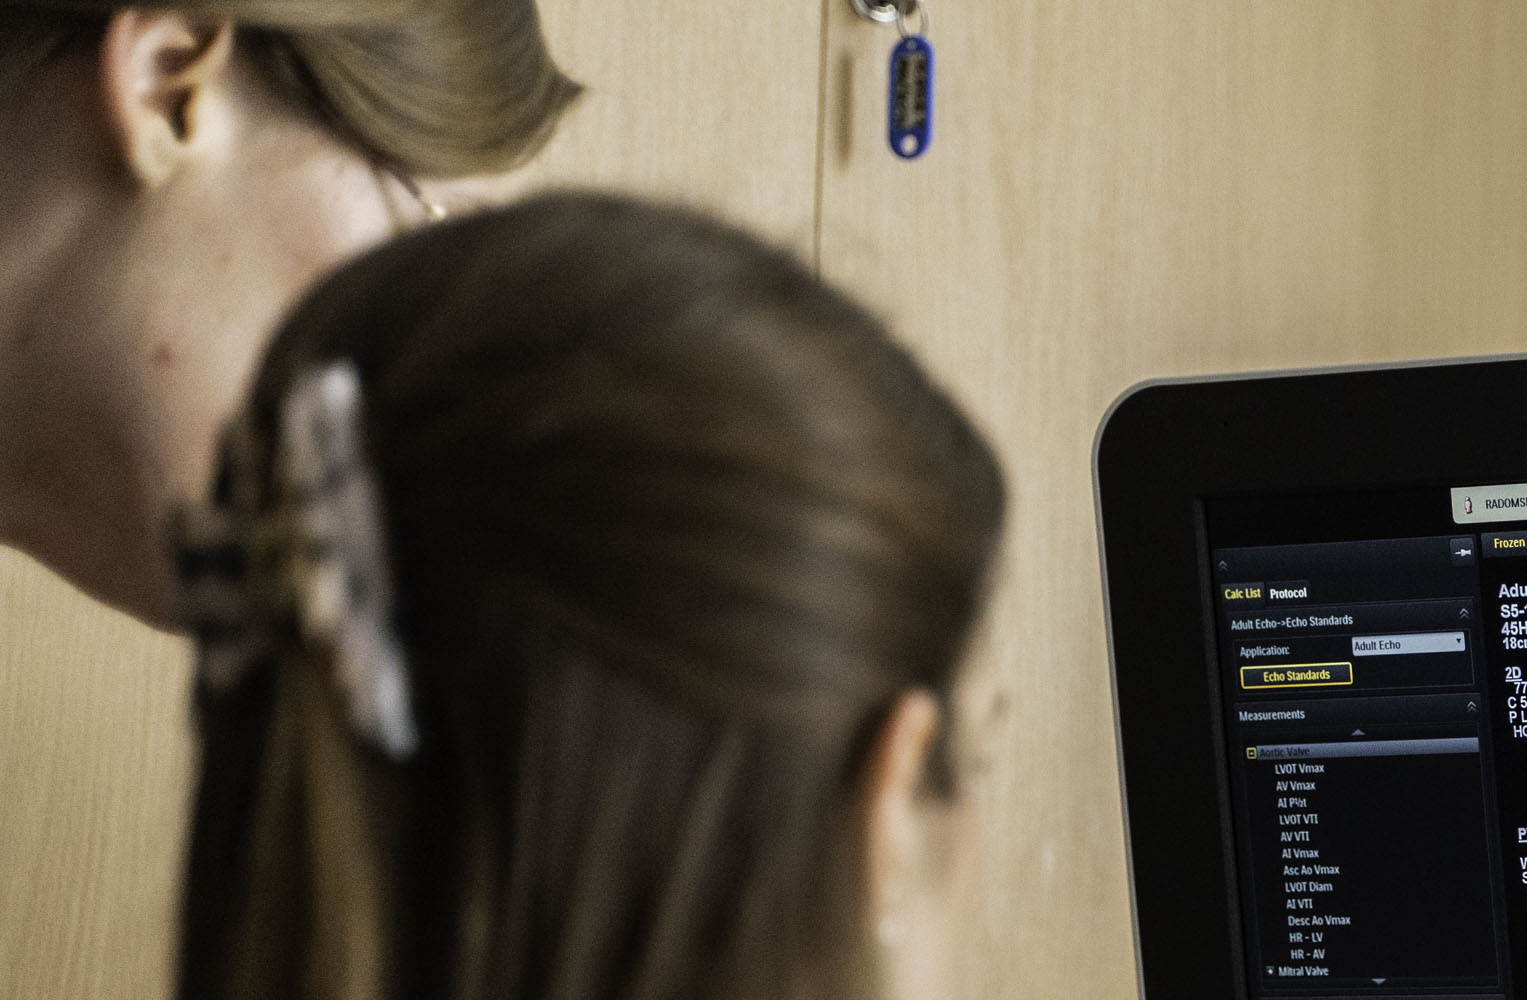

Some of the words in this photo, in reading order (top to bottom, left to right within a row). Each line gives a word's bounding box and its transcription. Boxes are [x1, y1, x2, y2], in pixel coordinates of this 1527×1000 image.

[1494, 536, 1526, 550] Frozen
[1224, 589, 1243, 600] Calc
[1245, 588, 1261, 598] List
[1270, 587, 1307, 600] Protocol
[1231, 619, 1254, 631] Adult
[1310, 614, 1354, 627] Standards
[1354, 639, 1376, 652] Adult
[1379, 638, 1401, 650] Echo
[1240, 646, 1290, 660] Application:
[1263, 671, 1286, 682] Echo
[1287, 670, 1330, 682] Standards
[1505, 666, 1522, 681] 2D
[1508, 696, 1517, 709] C
[1239, 709, 1306, 722] Measurements
[1509, 711, 1518, 724] P
[1275, 764, 1297, 775] LVOT
[1299, 762, 1325, 774] Vmax
[1276, 781, 1289, 792] AV
[1290, 780, 1316, 791] Vmax
[1280, 814, 1301, 825] LVOT
[1302, 814, 1318, 824] VTI
[1280, 832, 1293, 842] AV
[1294, 831, 1310, 842] VTI
[1293, 848, 1320, 858] Vmax
[1284, 866, 1299, 876] Asc
[1301, 866, 1312, 876] Ao
[1314, 865, 1340, 875] Vmax
[1285, 882, 1307, 892] LVOT
[1309, 882, 1333, 892] Diam
[1297, 898, 1312, 910] VTI
[1288, 916, 1310, 926] Desc
[1312, 916, 1324, 926] Ao
[1324, 914, 1351, 926] Vmax
[1290, 932, 1302, 943] HR
[1312, 932, 1323, 943] LV
[1290, 949, 1304, 960] HR
[1313, 949, 1326, 960] AV
[1278, 966, 1304, 976] Mitral
[1306, 966, 1329, 976] Valve
